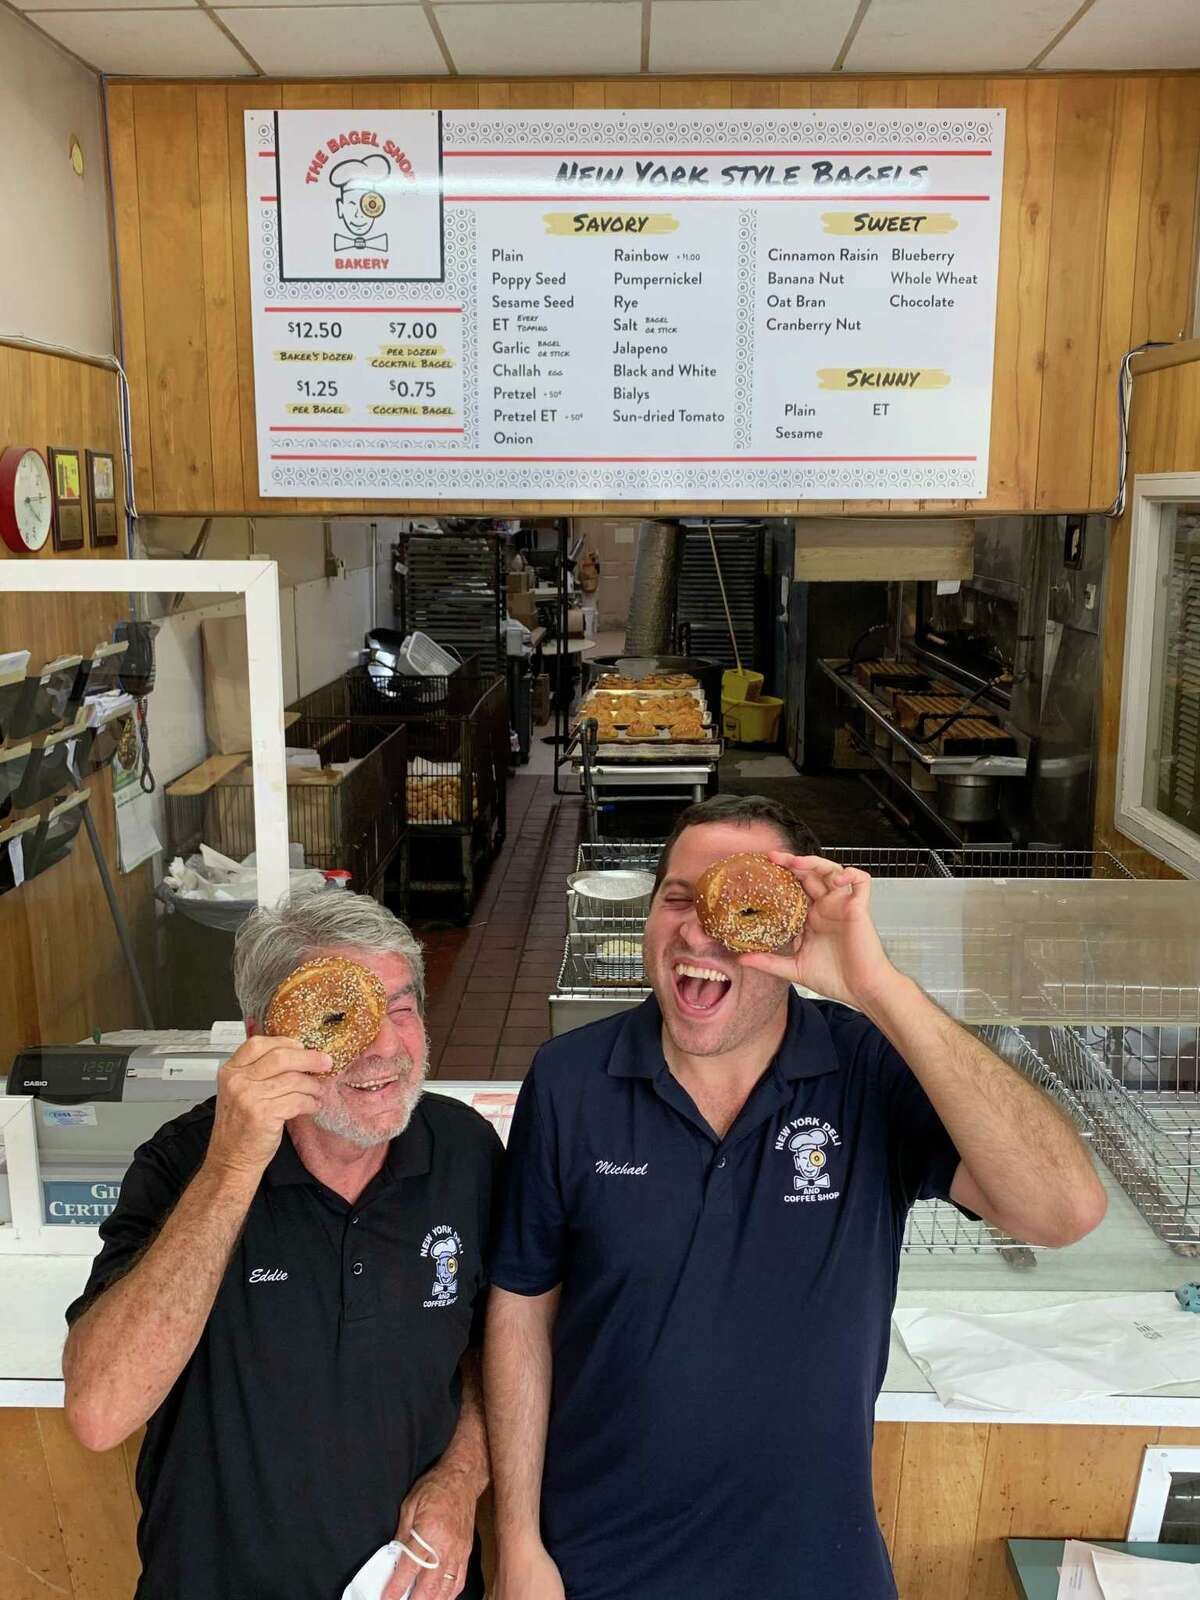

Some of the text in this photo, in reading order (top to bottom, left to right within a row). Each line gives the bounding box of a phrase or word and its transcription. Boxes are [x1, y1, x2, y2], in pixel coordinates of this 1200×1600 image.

[305, 150, 329, 184] THE
[327, 130, 379, 154] BAGEL
[555, 161, 929, 188] NEW YORK STYLE BAGELS
[572, 213, 650, 234] SAVORY
[853, 212, 927, 233] SWEET
[492, 248, 524, 262] Plain
[613, 248, 669, 262] Rainbow
[768, 248, 879, 262] Cinnamon Raisin
[891, 248, 955, 265] Blueberry
[334, 258, 390, 270] BAKERY
[492, 272, 566, 290] Poppy Seed
[613, 272, 702, 290] Pumpernickel
[768, 272, 845, 285] Banana Nut
[890, 271, 979, 284] Whole Wheat
[492, 295, 575, 308] Sesame Seed
[613, 295, 639, 313] Rye
[767, 295, 826, 308] Oat Bran
[889, 295, 955, 308] Chocolate
[288, 321, 342, 339] $12.50
[389, 322, 438, 339] $7.00
[493, 318, 510, 331] ET
[613, 318, 638, 331] Salt
[766, 318, 862, 335] Cranberry Nut
[386, 348, 438, 356] PER DOZEN
[492, 341, 531, 354] Garlic
[612, 341, 669, 359] Jalapeno
[279, 351, 354, 361] BAKER'S DOZEN
[371, 359, 454, 368] COCKTAIL BAGEL
[492, 364, 541, 377] Challah
[613, 364, 717, 377] Black and White
[846, 368, 921, 388] SKINNY
[297, 380, 338, 397] $1.25
[389, 380, 436, 398] $0.75
[493, 386, 536, 400] Pretzel
[613, 386, 650, 405] Bialys
[292, 405, 345, 414] PER BAGEL
[372, 405, 454, 415] COCKTAIL BAGEL
[494, 409, 536, 422] Pretzel
[541, 409, 558, 422] ET
[612, 409, 726, 422] Sun-dried Tomato
[784, 403, 816, 416] Plain
[873, 403, 890, 416] ET
[493, 431, 534, 444] Onion
[775, 426, 824, 439] Sesame
[23, 1080, 49, 1088] CASIO
[774, 1116, 842, 1151] NEW YORK DELI
[595, 1160, 650, 1176] Michael
[783, 1191, 840, 1203] COFFEE SHOP
[803, 1187, 821, 1195] AND
[420, 1232, 433, 1257] NEW
[432, 1224, 453, 1237] YORK
[248, 1268, 289, 1283] Eddie
[423, 1299, 447, 1308] COFFEE
